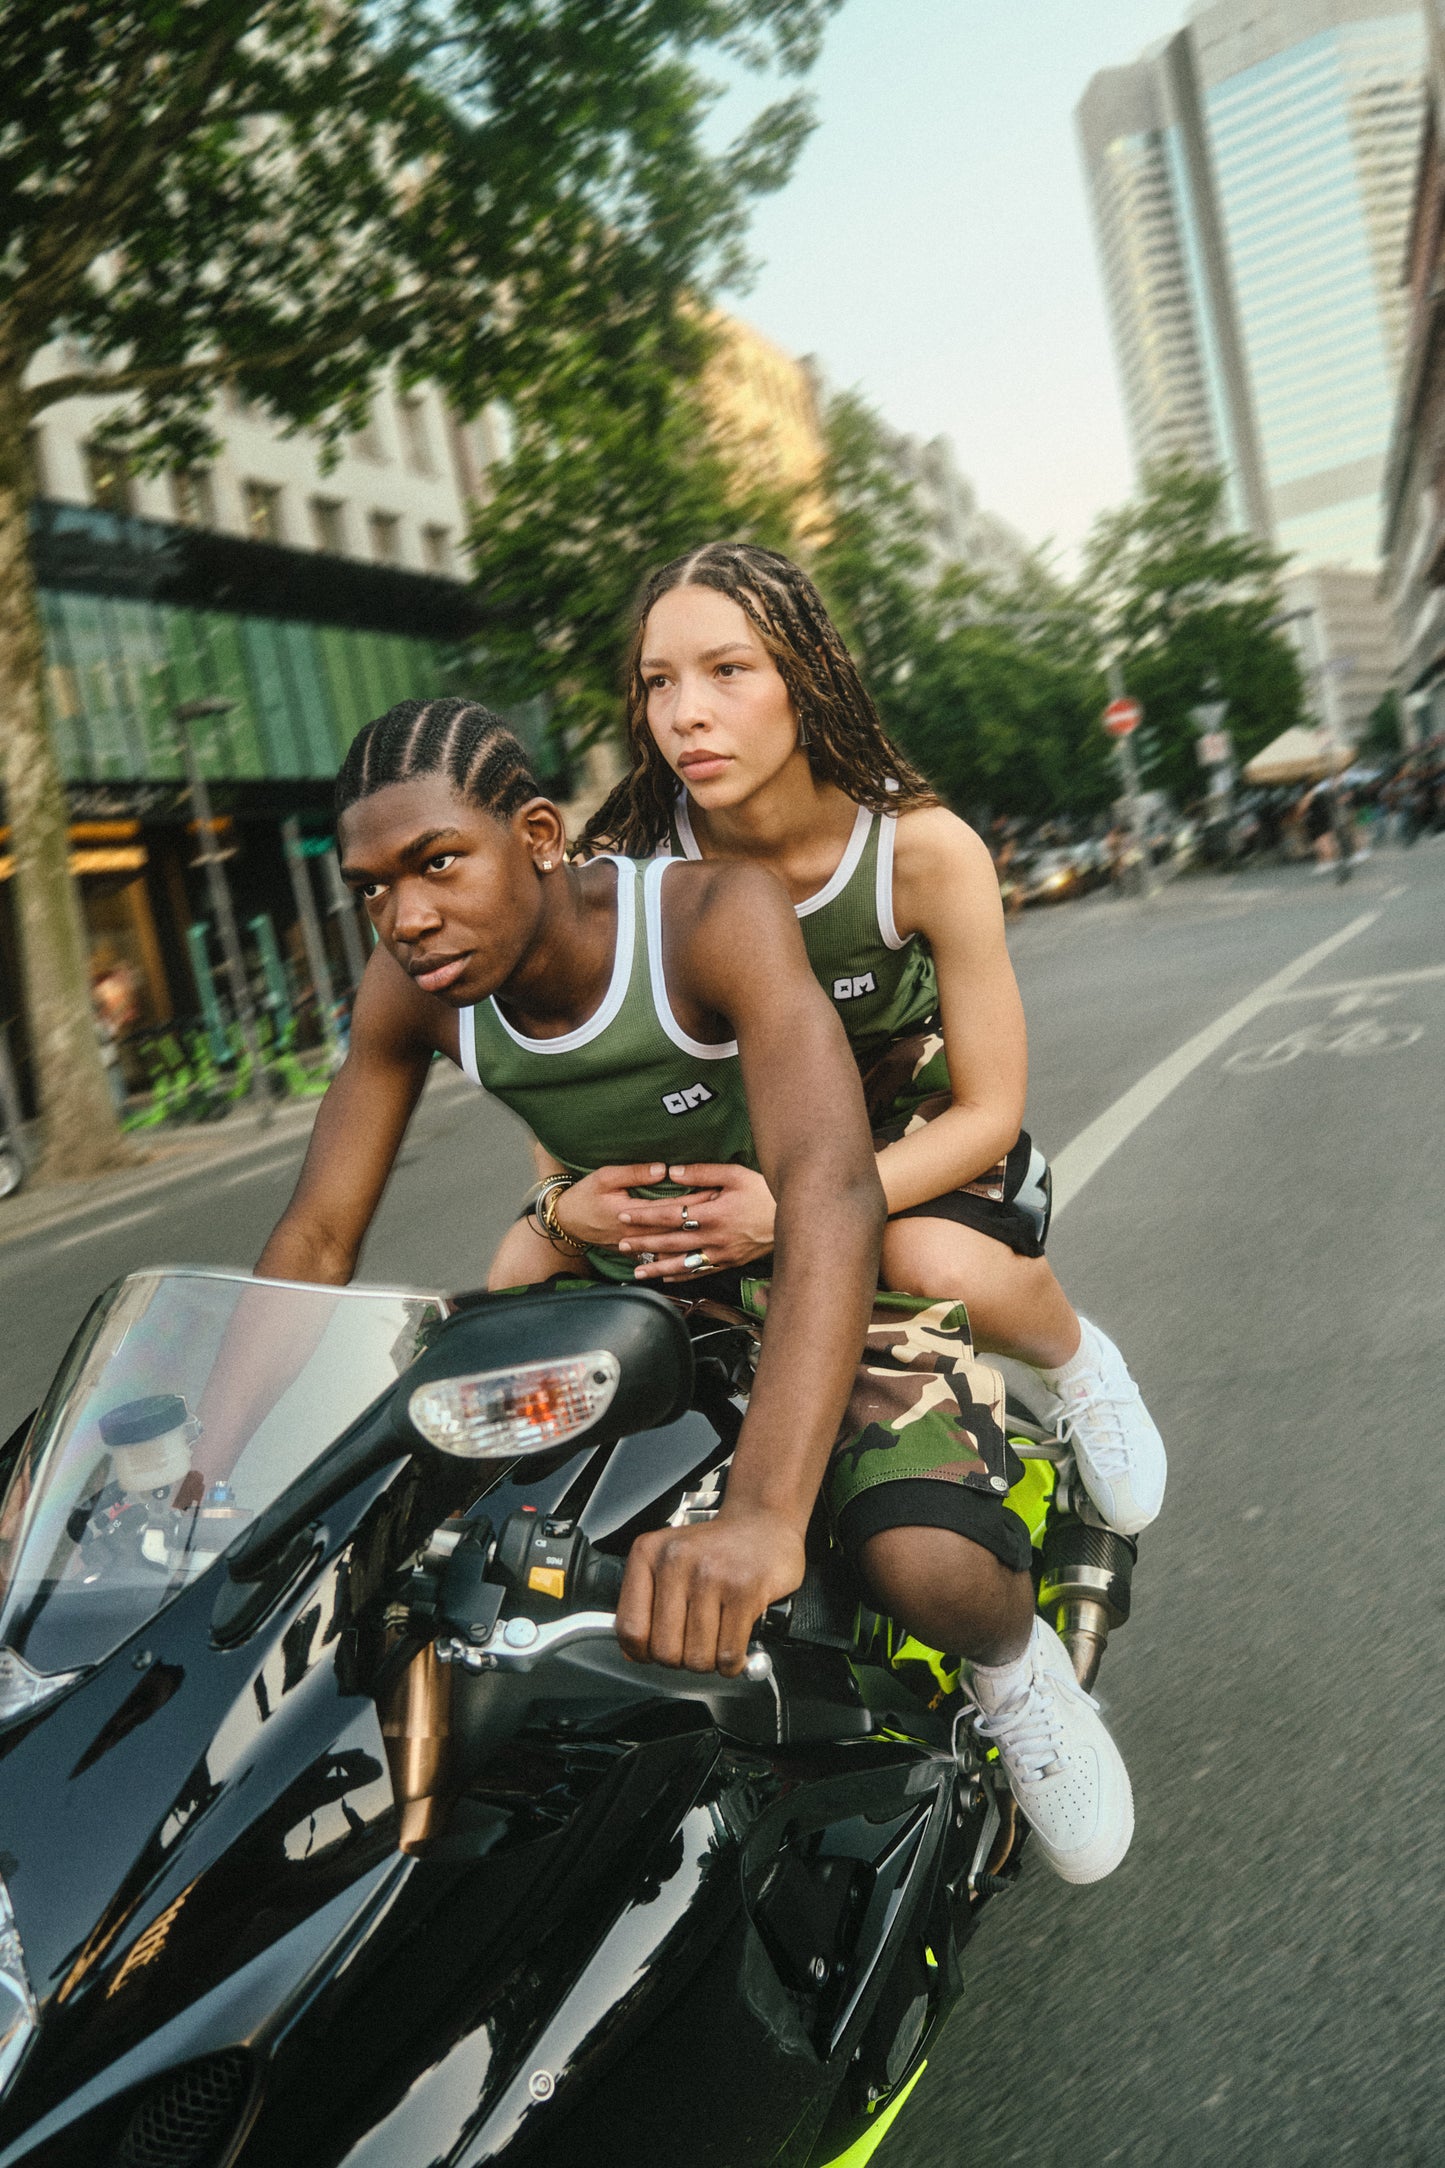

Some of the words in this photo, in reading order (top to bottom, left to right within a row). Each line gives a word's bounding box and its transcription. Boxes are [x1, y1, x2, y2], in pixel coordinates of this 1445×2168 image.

[832, 971, 876, 1000] OM
[661, 1082, 713, 1115] OM
[545, 1556, 563, 1566] PASS
